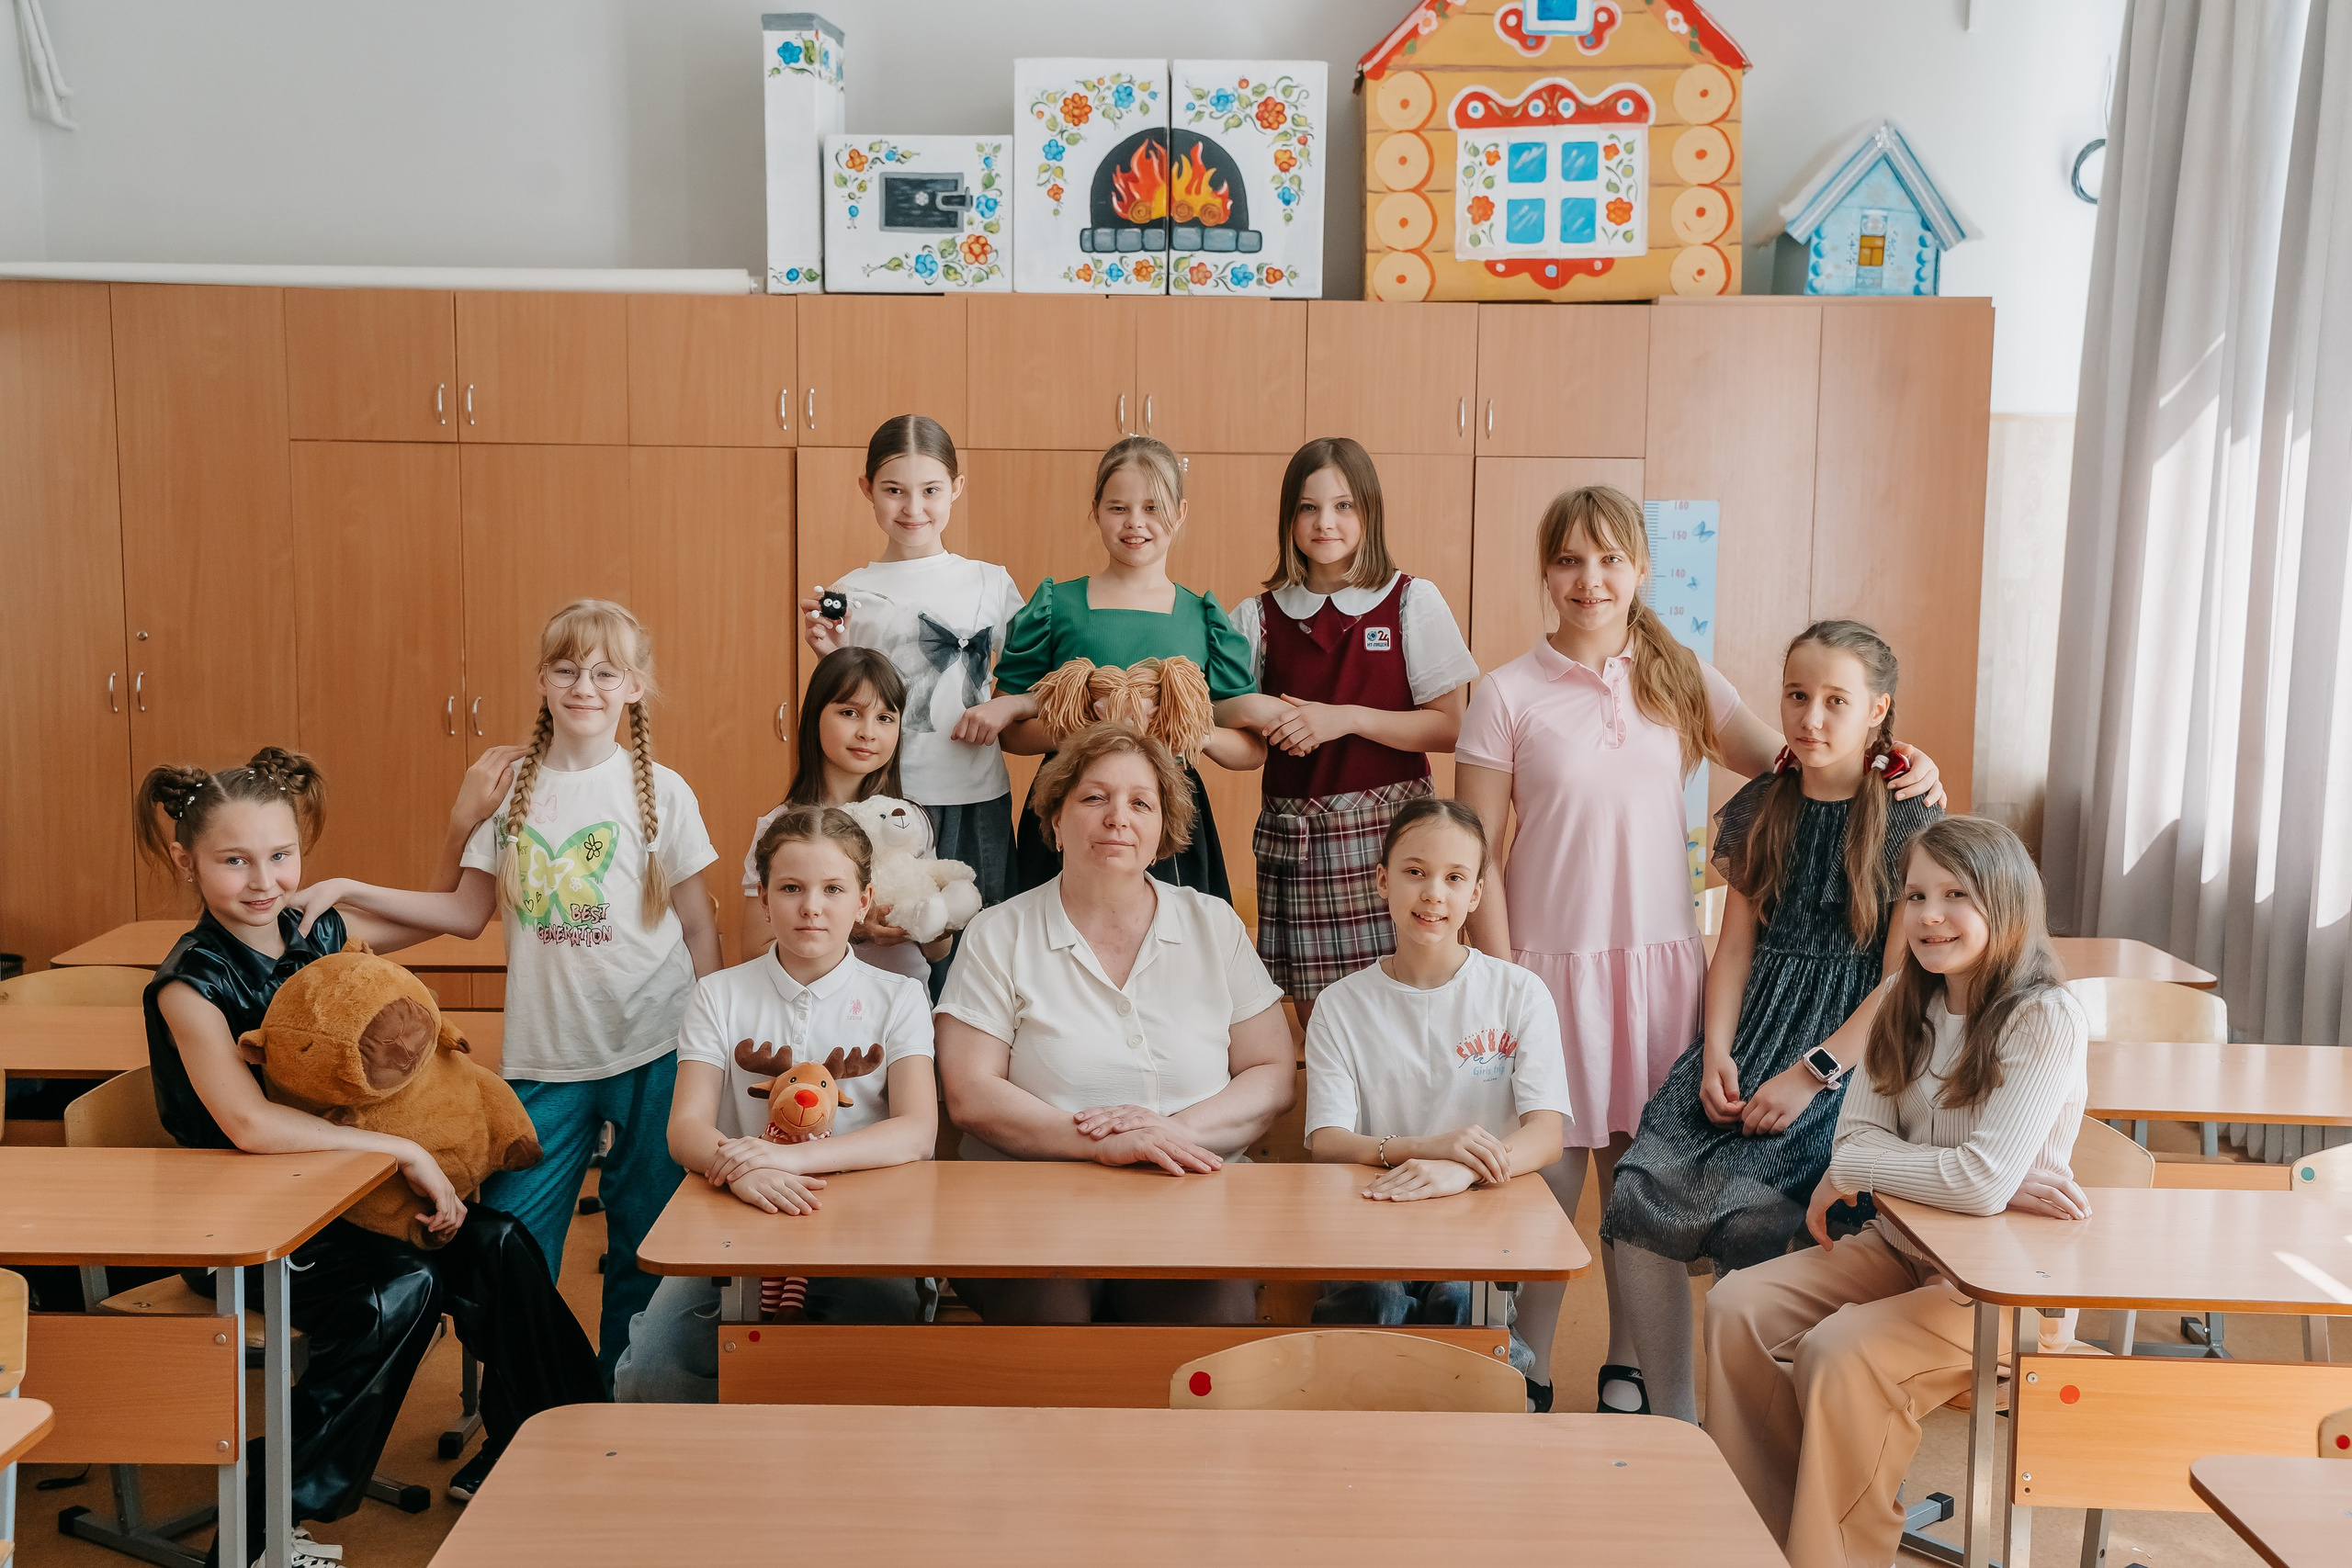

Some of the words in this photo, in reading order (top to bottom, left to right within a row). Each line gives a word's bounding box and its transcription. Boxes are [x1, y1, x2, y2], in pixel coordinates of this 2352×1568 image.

[1674, 501, 1690, 511] 160
[1673, 531, 1687, 539] 150
[1671, 569, 1685, 578] 140
[1669, 606, 1685, 615] 130
[1377, 630, 1389, 647] 24
[570, 902, 610, 924] BEST
[537, 922, 612, 947] GENERATION
[1473, 1066, 1492, 1077] Girls
[1493, 1065, 1506, 1076] trip
